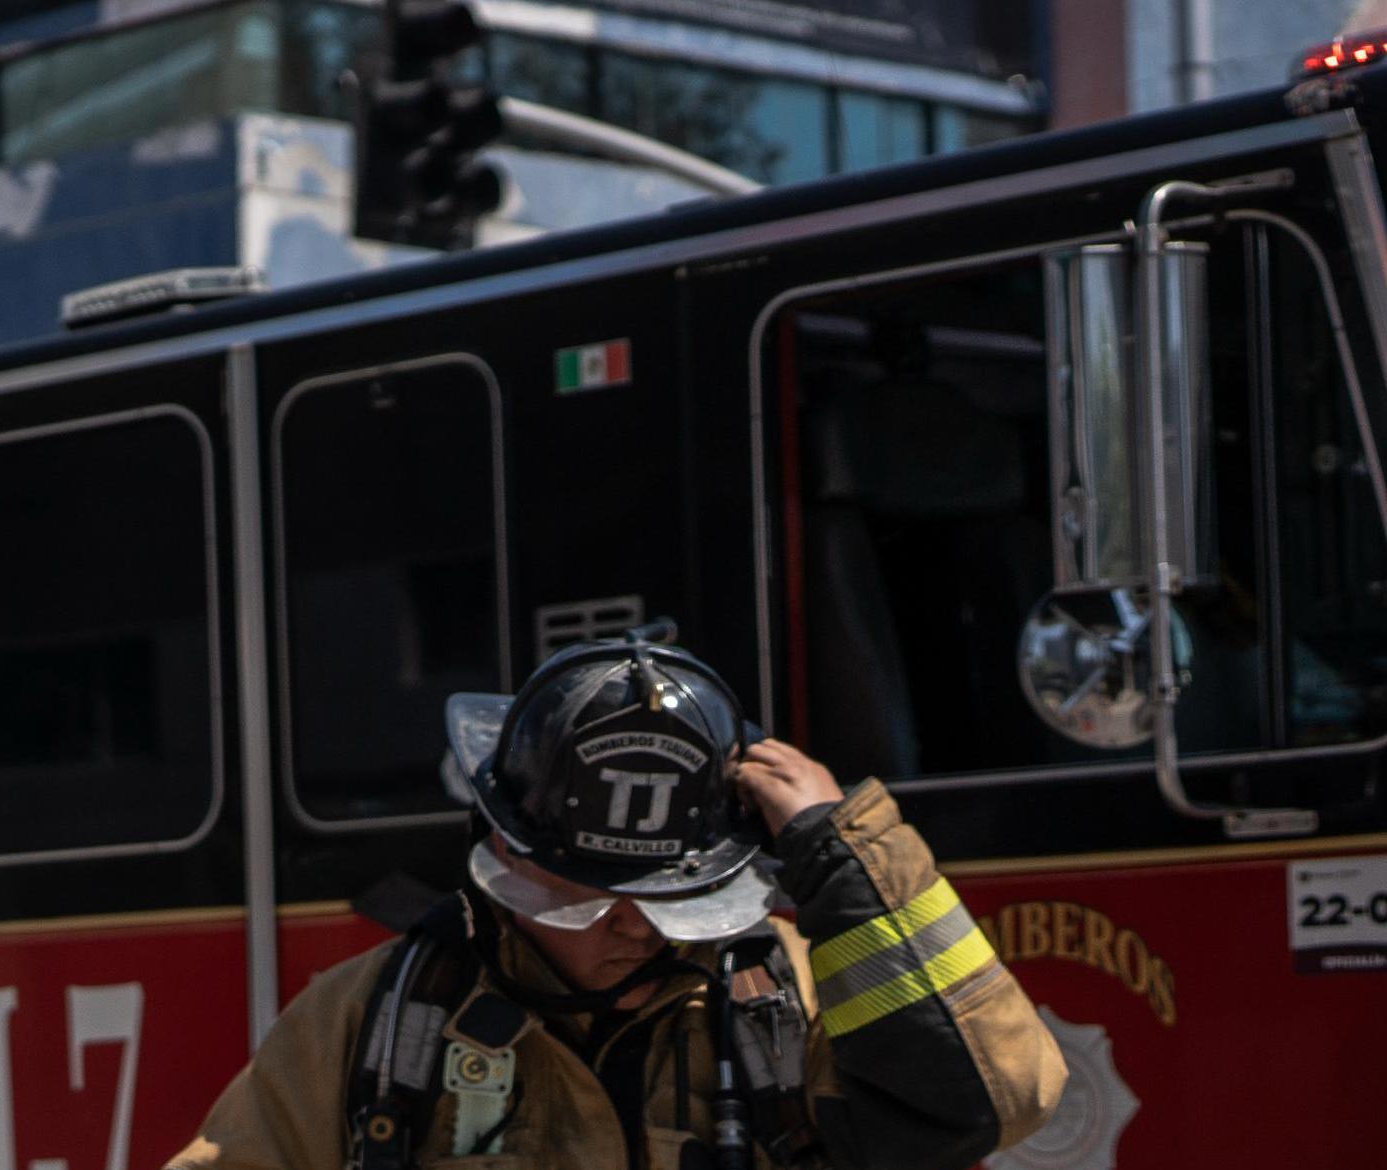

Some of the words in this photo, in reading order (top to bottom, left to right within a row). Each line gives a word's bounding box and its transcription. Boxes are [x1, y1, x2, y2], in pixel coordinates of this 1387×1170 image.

[582, 736, 656, 757] BOMBEROS
[600, 768, 681, 833] TJ
[976, 900, 1178, 1028] MBEROS
